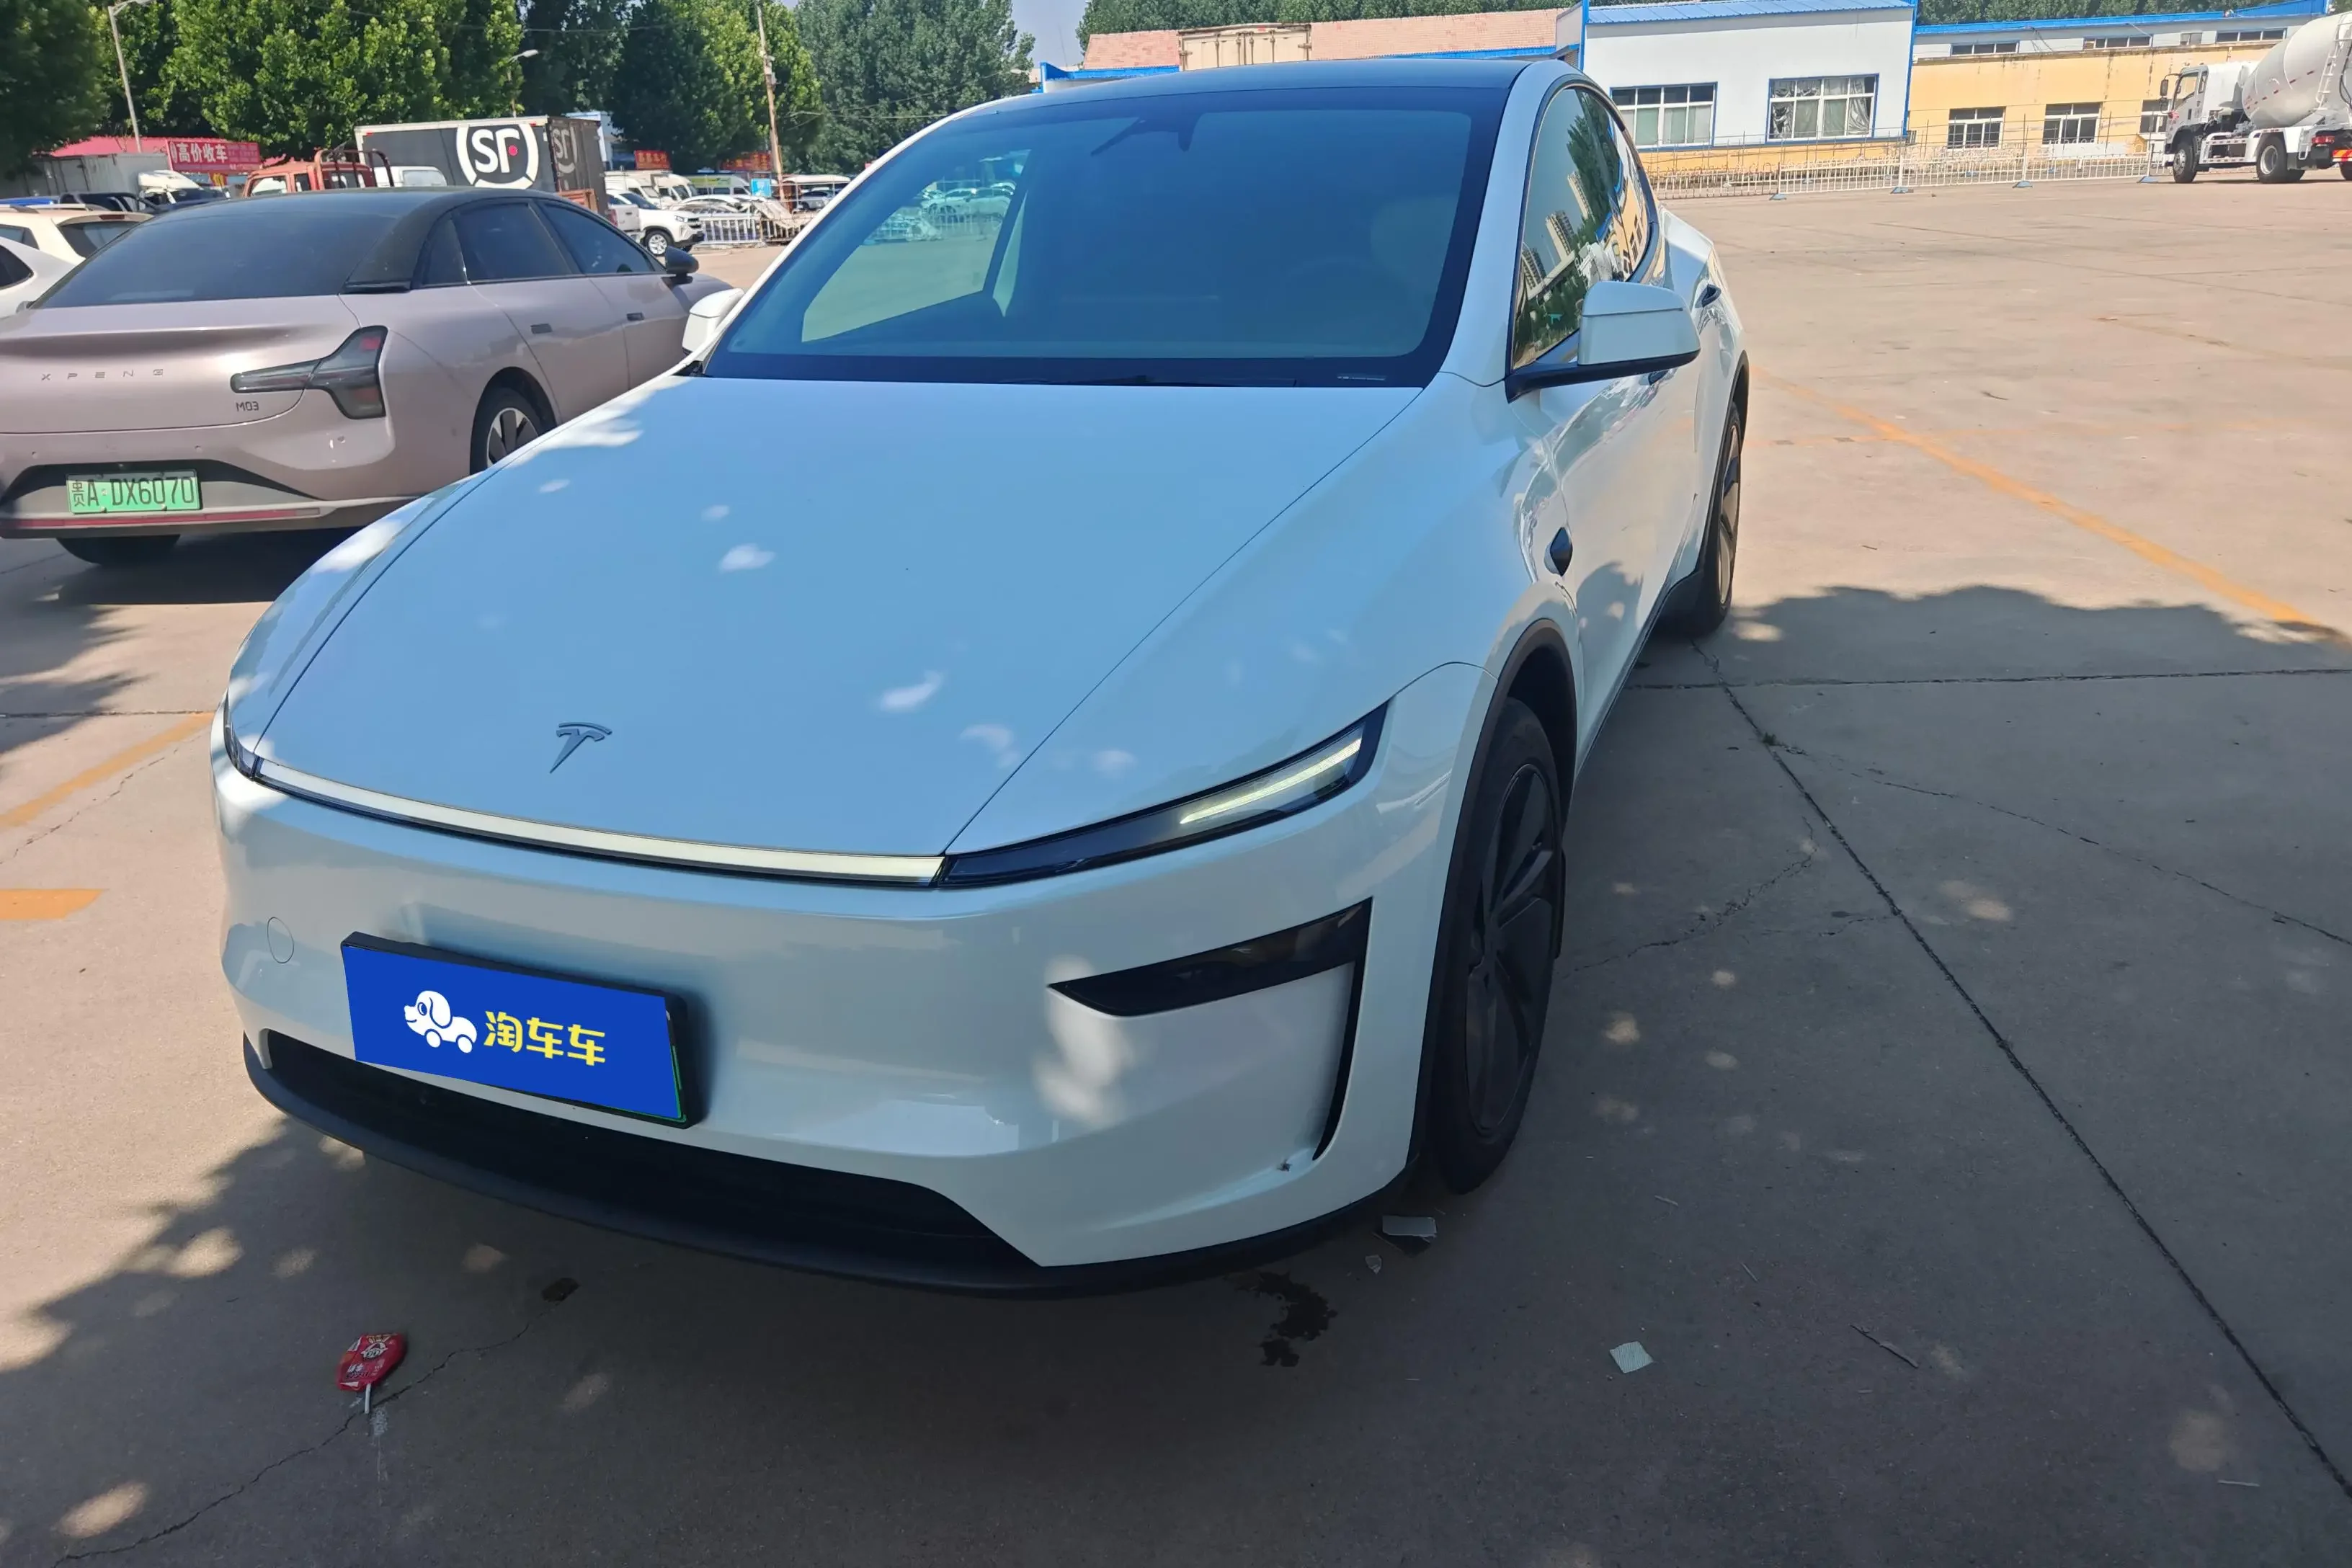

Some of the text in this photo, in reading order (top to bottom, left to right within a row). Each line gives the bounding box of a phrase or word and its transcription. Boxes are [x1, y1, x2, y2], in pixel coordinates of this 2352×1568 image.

[177, 143, 228, 163] 高价收车
[471, 128, 520, 173] SF
[41, 368, 164, 381] XPENG
[236, 401, 259, 411] M03
